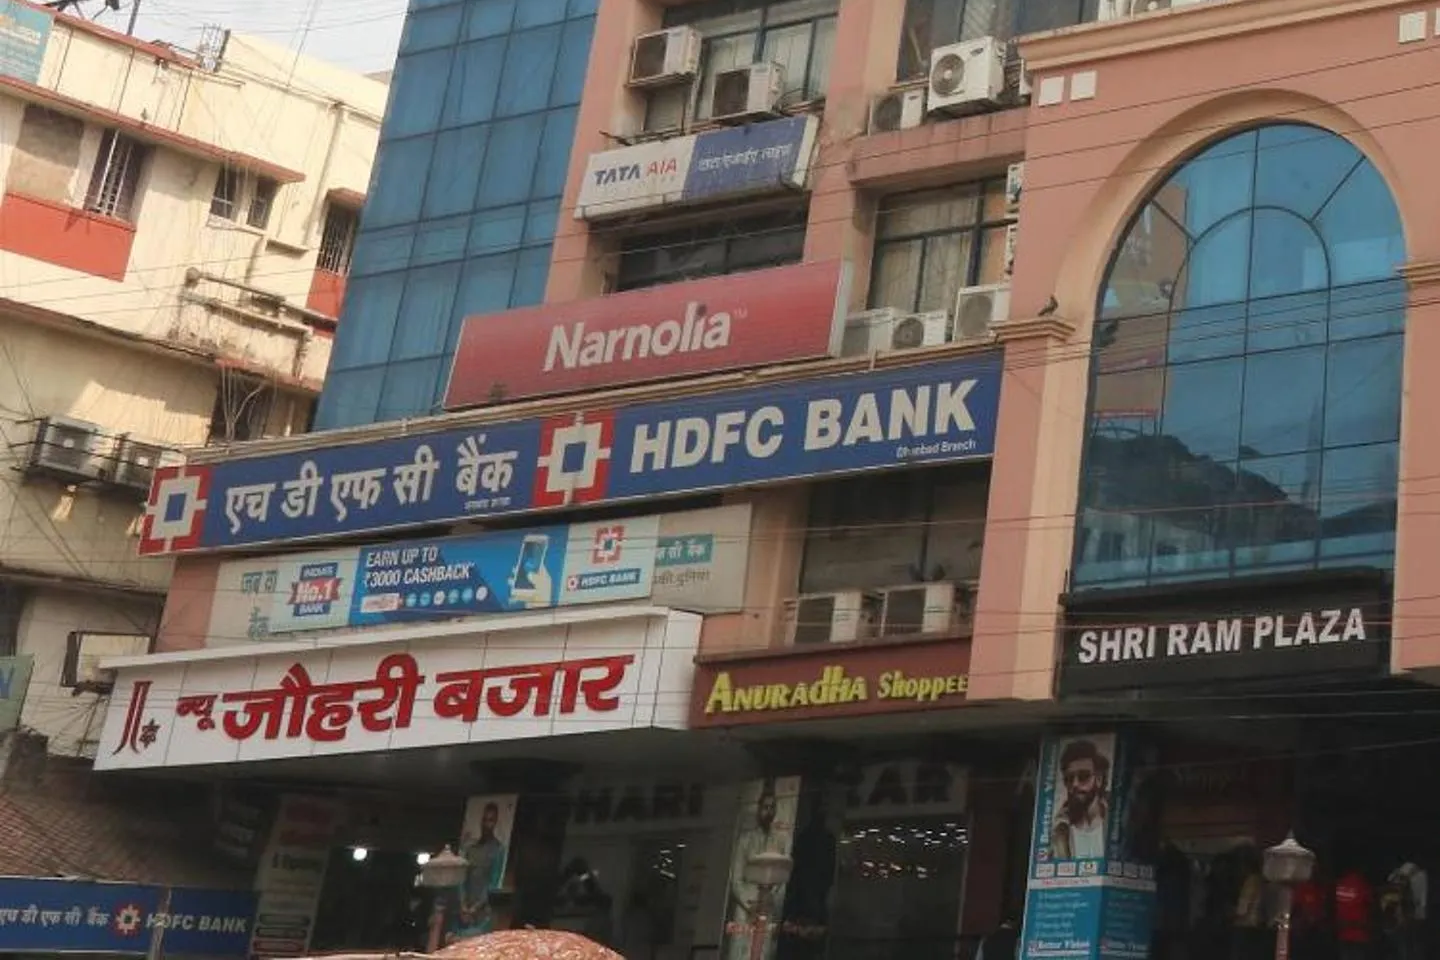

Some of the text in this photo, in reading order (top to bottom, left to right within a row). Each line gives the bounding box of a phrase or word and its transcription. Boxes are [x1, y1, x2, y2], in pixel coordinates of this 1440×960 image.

[594, 157, 677, 186] TATA AIA
[543, 301, 732, 372] Narnolia
[629, 378, 979, 474] HDFC BANK
[225, 432, 518, 535] एच डी एफ सी बैंक
[366, 546, 439, 568] EARN UP TO
[1078, 608, 1366, 664] SHRI RAM PLAZA
[221, 653, 425, 742] जौहरी
[432, 654, 635, 724] बजार
[198, 914, 248, 933] BANK
